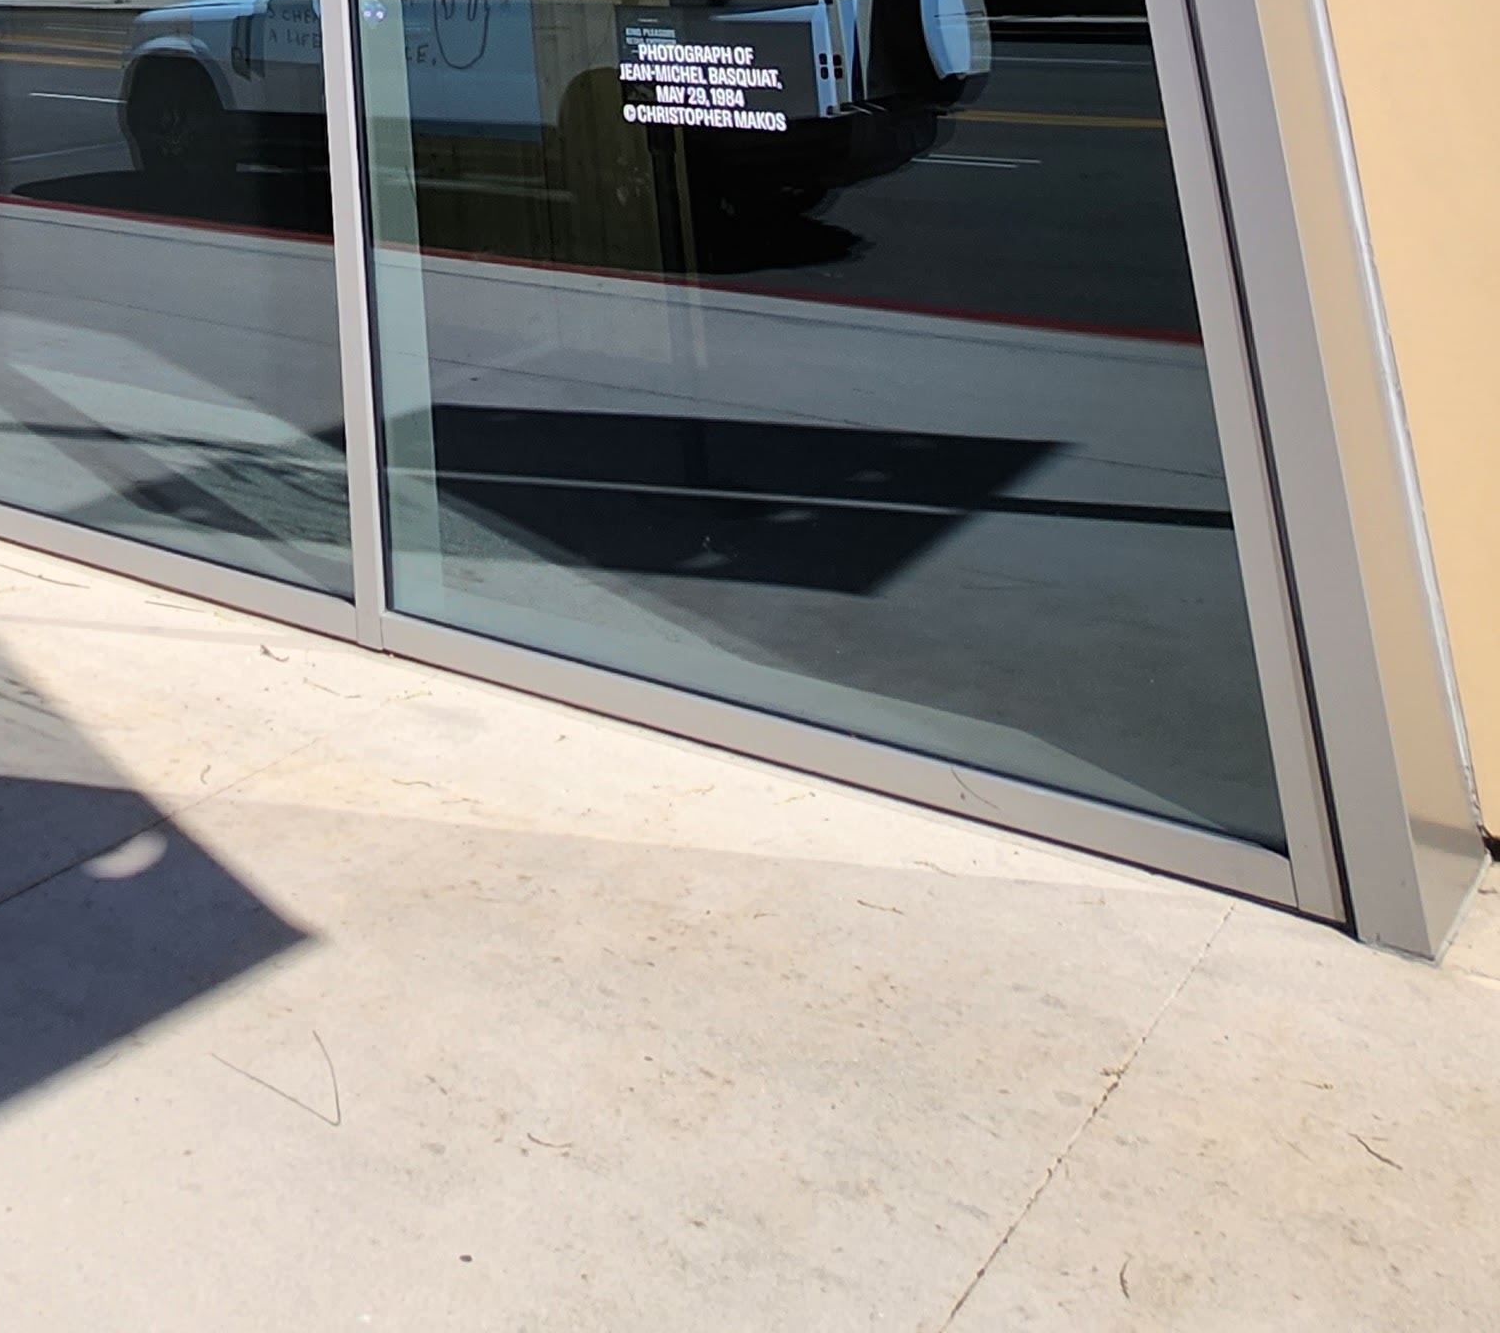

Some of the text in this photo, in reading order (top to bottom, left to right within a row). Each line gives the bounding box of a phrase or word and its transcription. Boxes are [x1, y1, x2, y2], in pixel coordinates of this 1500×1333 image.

[638, 43, 755, 66] PHOTOGRAPH OF
[619, 62, 708, 86] JEAN-MICHEL
[655, 85, 686, 104] MAY
[733, 111, 788, 132] MAKOS
